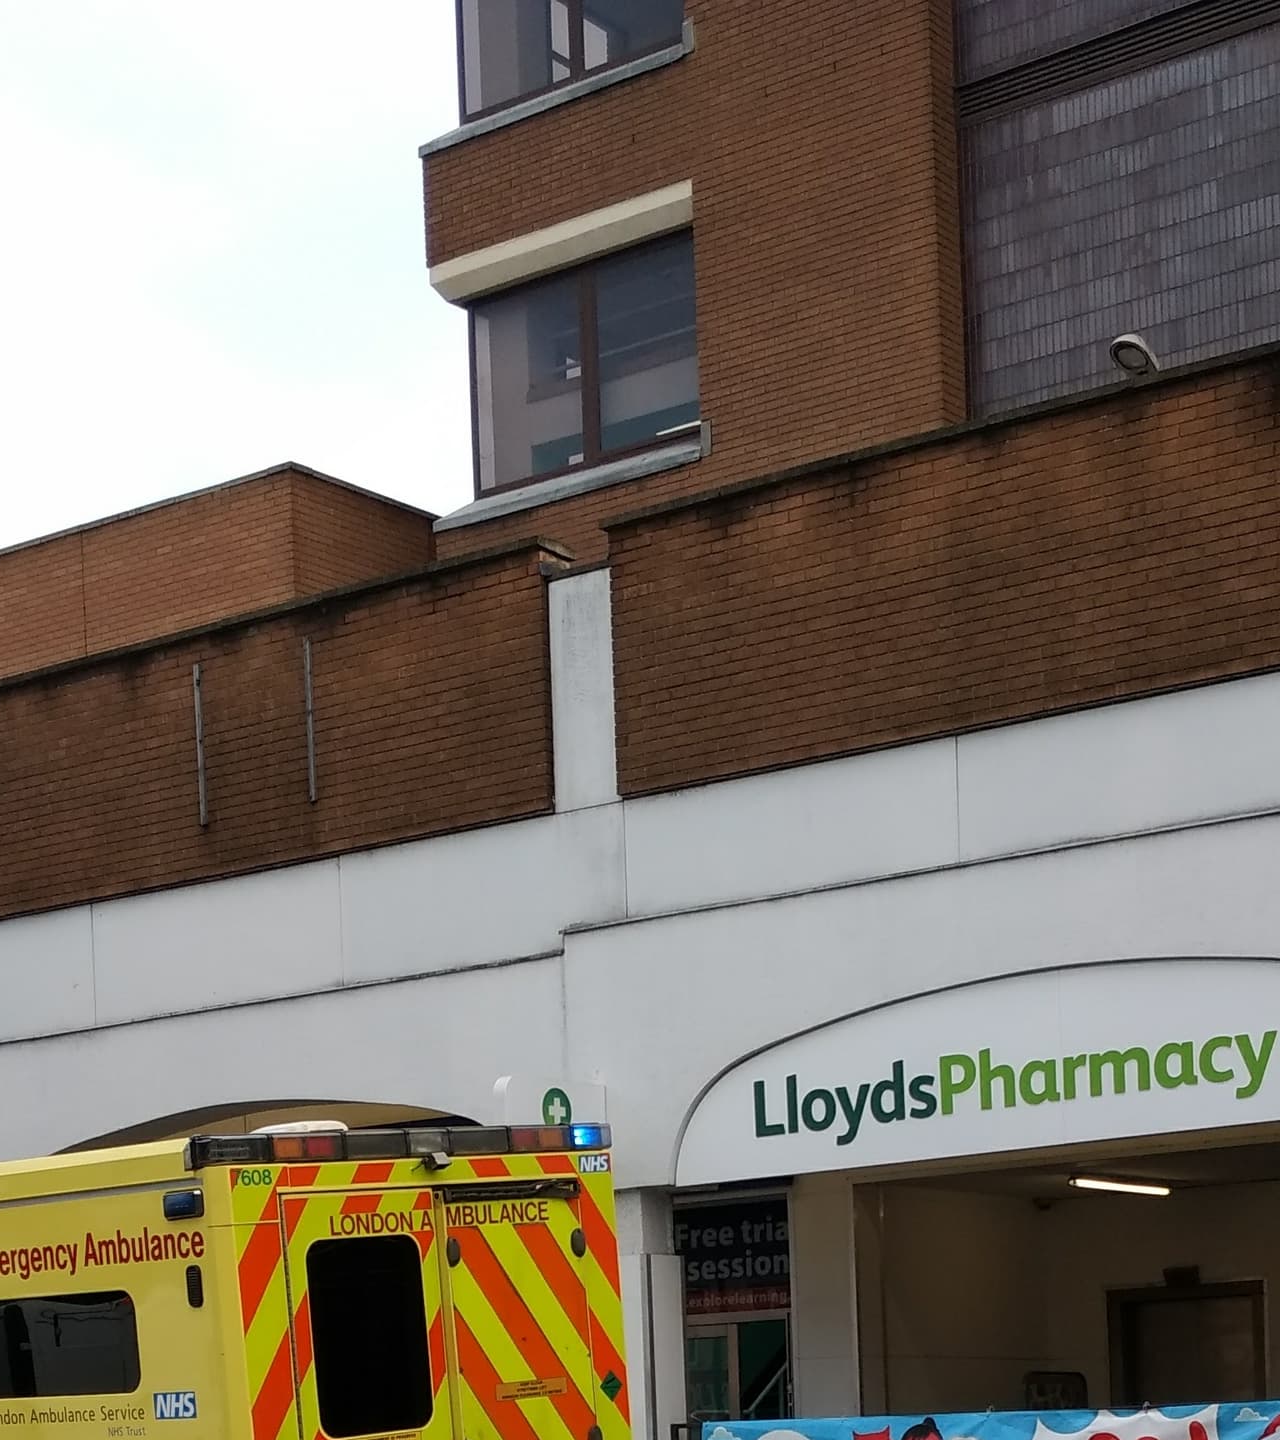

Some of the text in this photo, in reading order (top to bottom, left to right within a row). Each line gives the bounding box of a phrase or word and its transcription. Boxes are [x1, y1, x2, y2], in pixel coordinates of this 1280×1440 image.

[753, 1029, 1277, 1146] LloydsPharmacy
[580, 1155, 609, 1172] NHS
[329, 1211, 413, 1236] LONDON
[675, 1215, 788, 1249] Free tria
[83, 1227, 205, 1267] Ambulance
[30, 1405, 96, 1424] Ambulance
[99, 1404, 145, 1422] Service
[154, 1393, 196, 1418] NHS
[108, 1426, 146, 1437] NHS Trust
